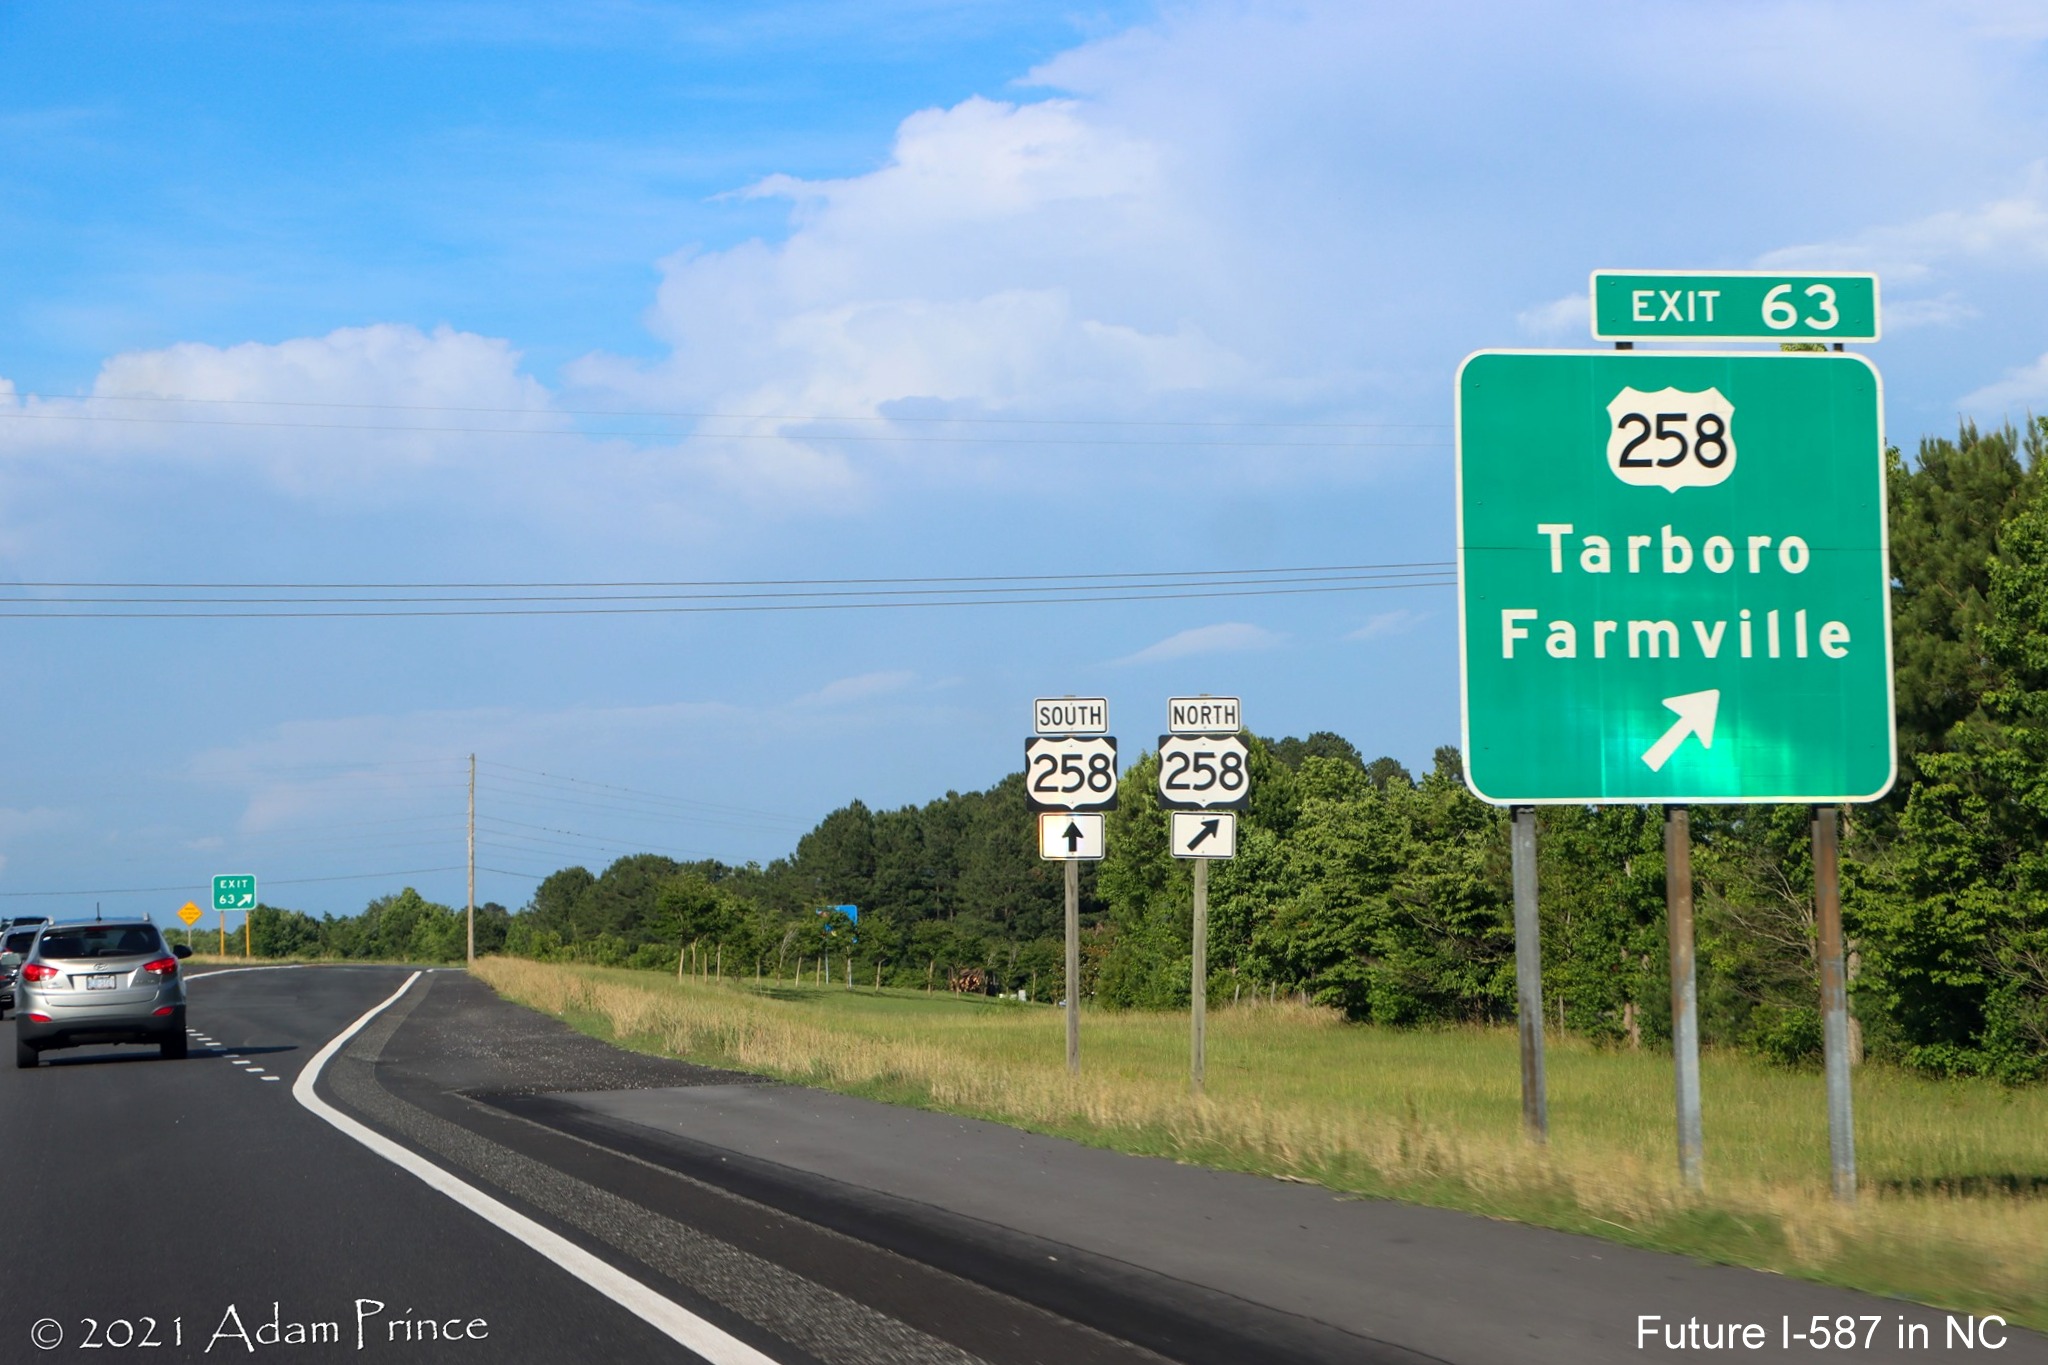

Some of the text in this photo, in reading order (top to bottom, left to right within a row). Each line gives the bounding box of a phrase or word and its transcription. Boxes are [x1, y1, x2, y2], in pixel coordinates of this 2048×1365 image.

[1632, 284, 1840, 331] EXIT 63
[1617, 412, 1728, 469] 258
[1537, 523, 1811, 574] Tarboro
[1501, 608, 1851, 659] Farmville
[1039, 705, 1102, 726] SOUTH
[1173, 705, 1236, 725] NORTH
[1033, 753, 1112, 793] 258
[1165, 751, 1244, 791] 258
[219, 894, 235, 904] 63
[220, 880, 248, 888] EXIT
